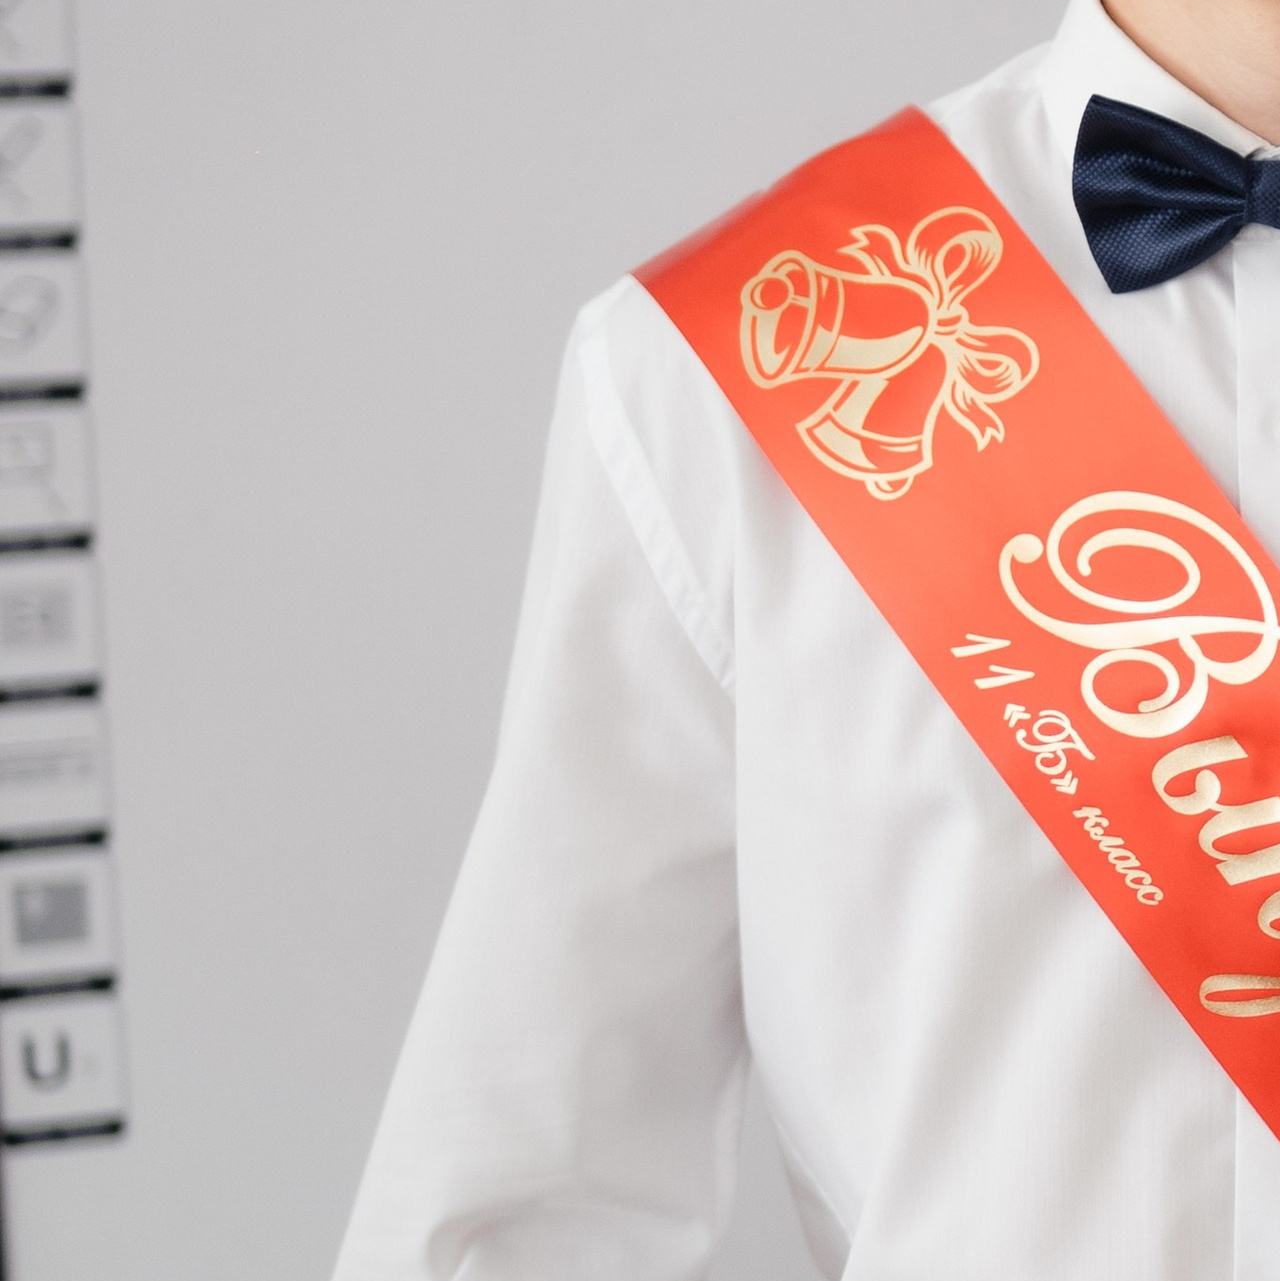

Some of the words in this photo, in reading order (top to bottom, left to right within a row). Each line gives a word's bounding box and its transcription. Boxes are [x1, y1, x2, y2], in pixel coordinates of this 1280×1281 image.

[950, 633, 1035, 689] 11
[1003, 703, 1095, 795] «Б»
[1072, 806, 1164, 906] класс
